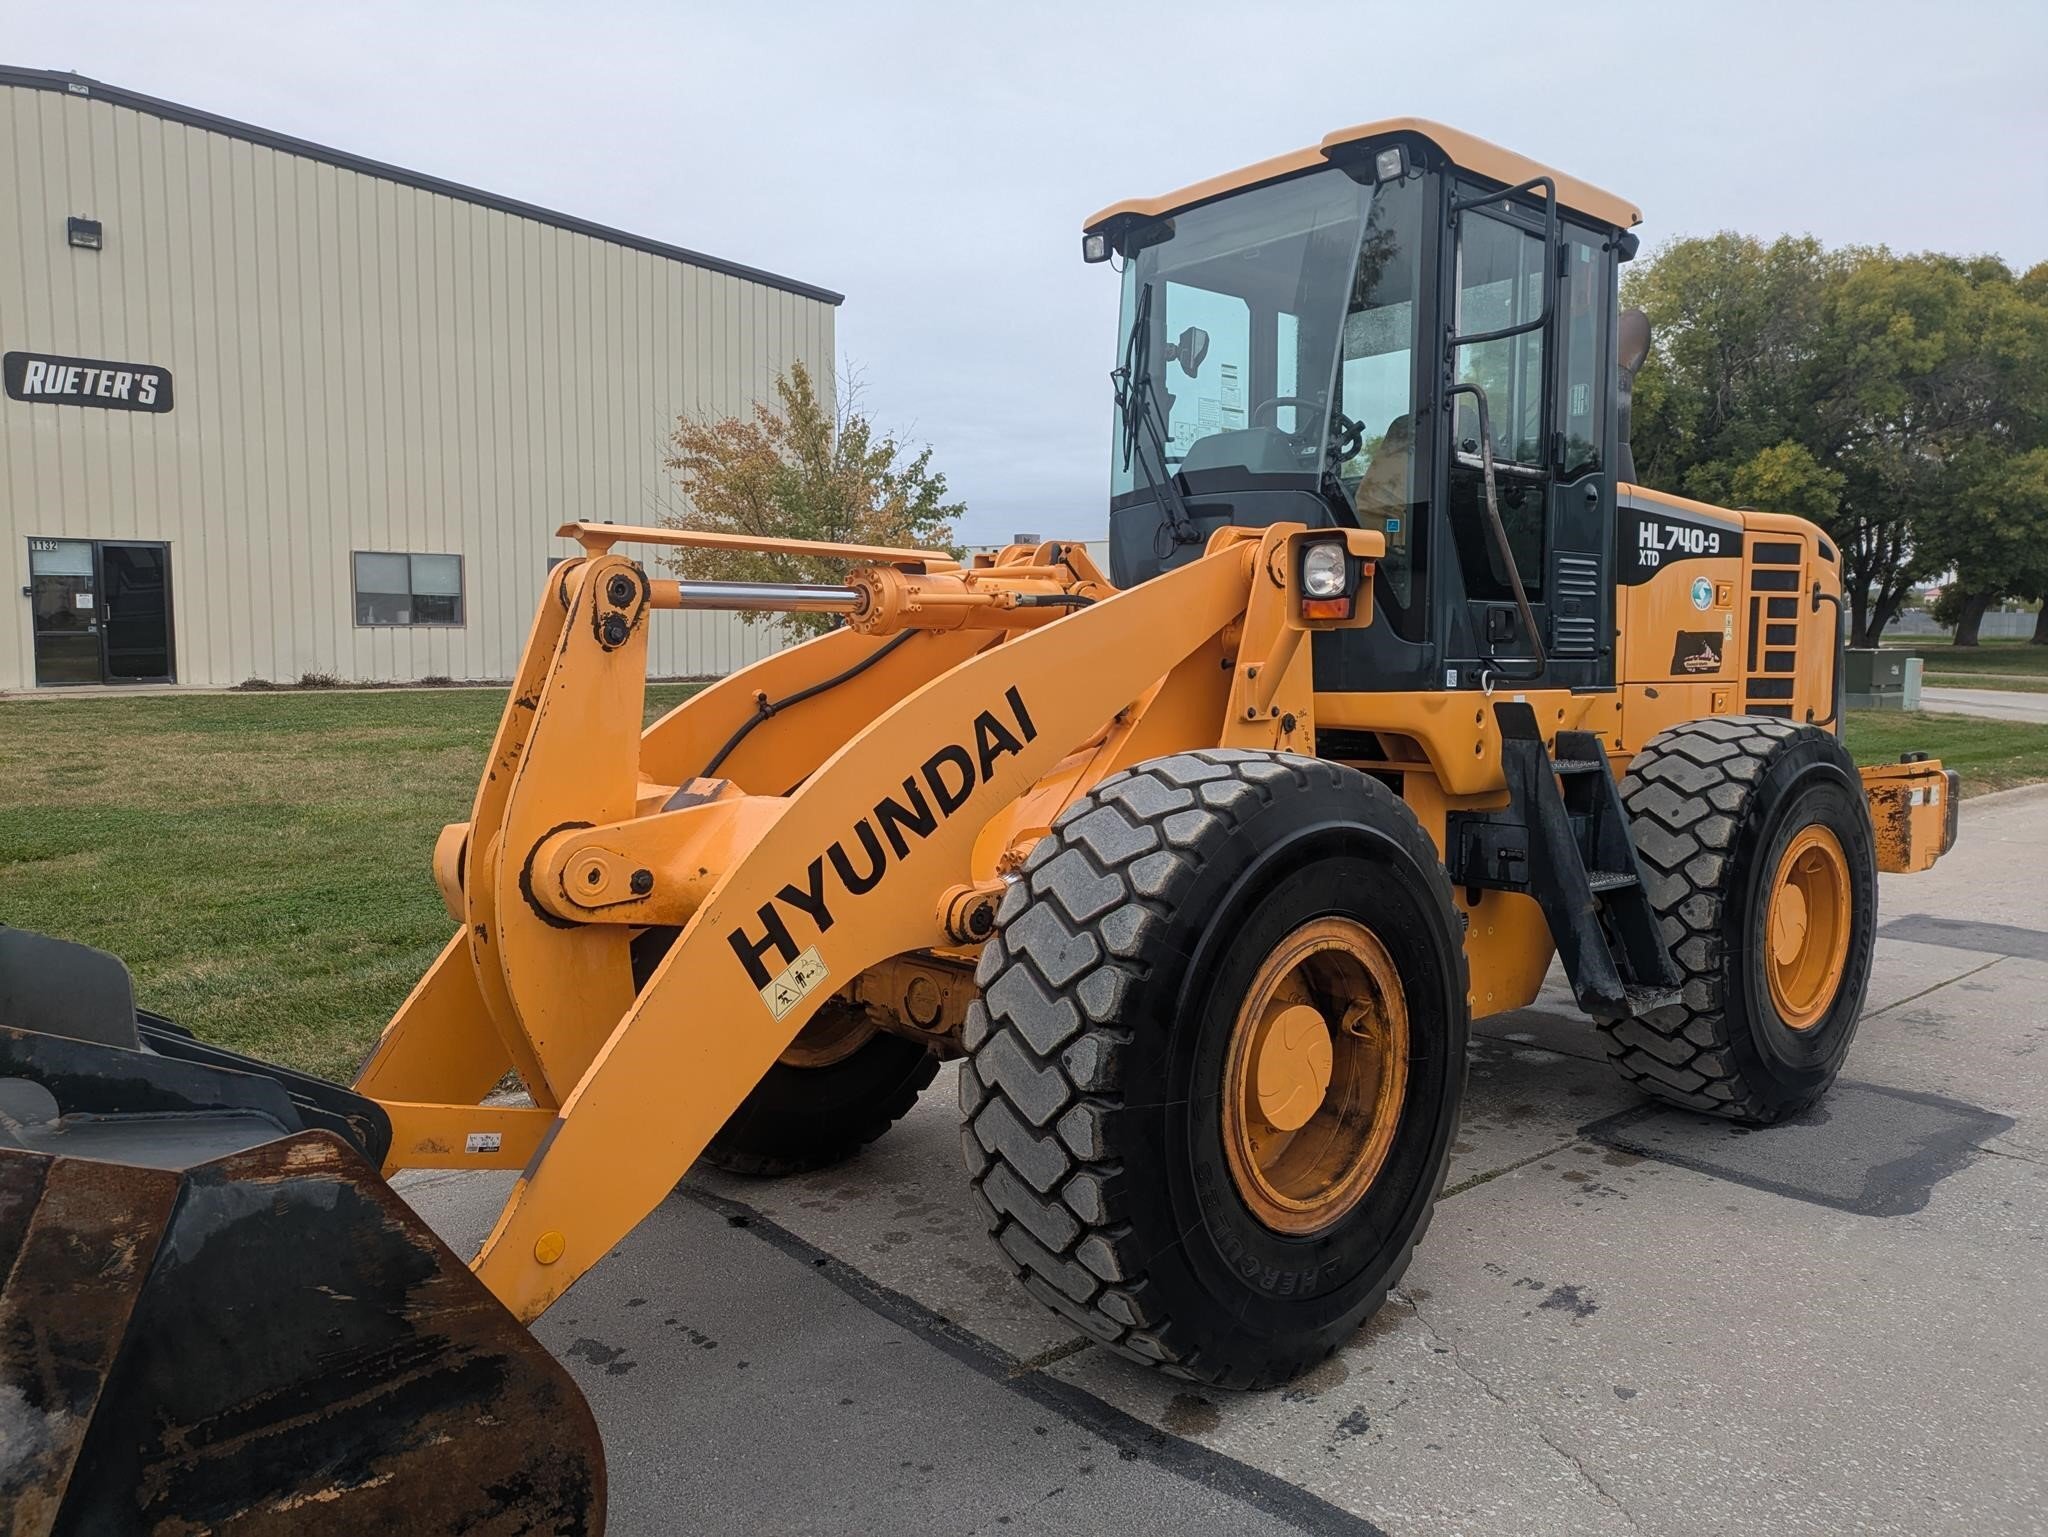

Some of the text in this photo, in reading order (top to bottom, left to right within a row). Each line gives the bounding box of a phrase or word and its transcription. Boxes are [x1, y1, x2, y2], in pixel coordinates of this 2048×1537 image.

[22, 360, 159, 405] RUETER'S
[33, 540, 57, 550] 1132
[1638, 549, 1660, 566] XTD
[726, 685, 1038, 992] HYUNDAI
